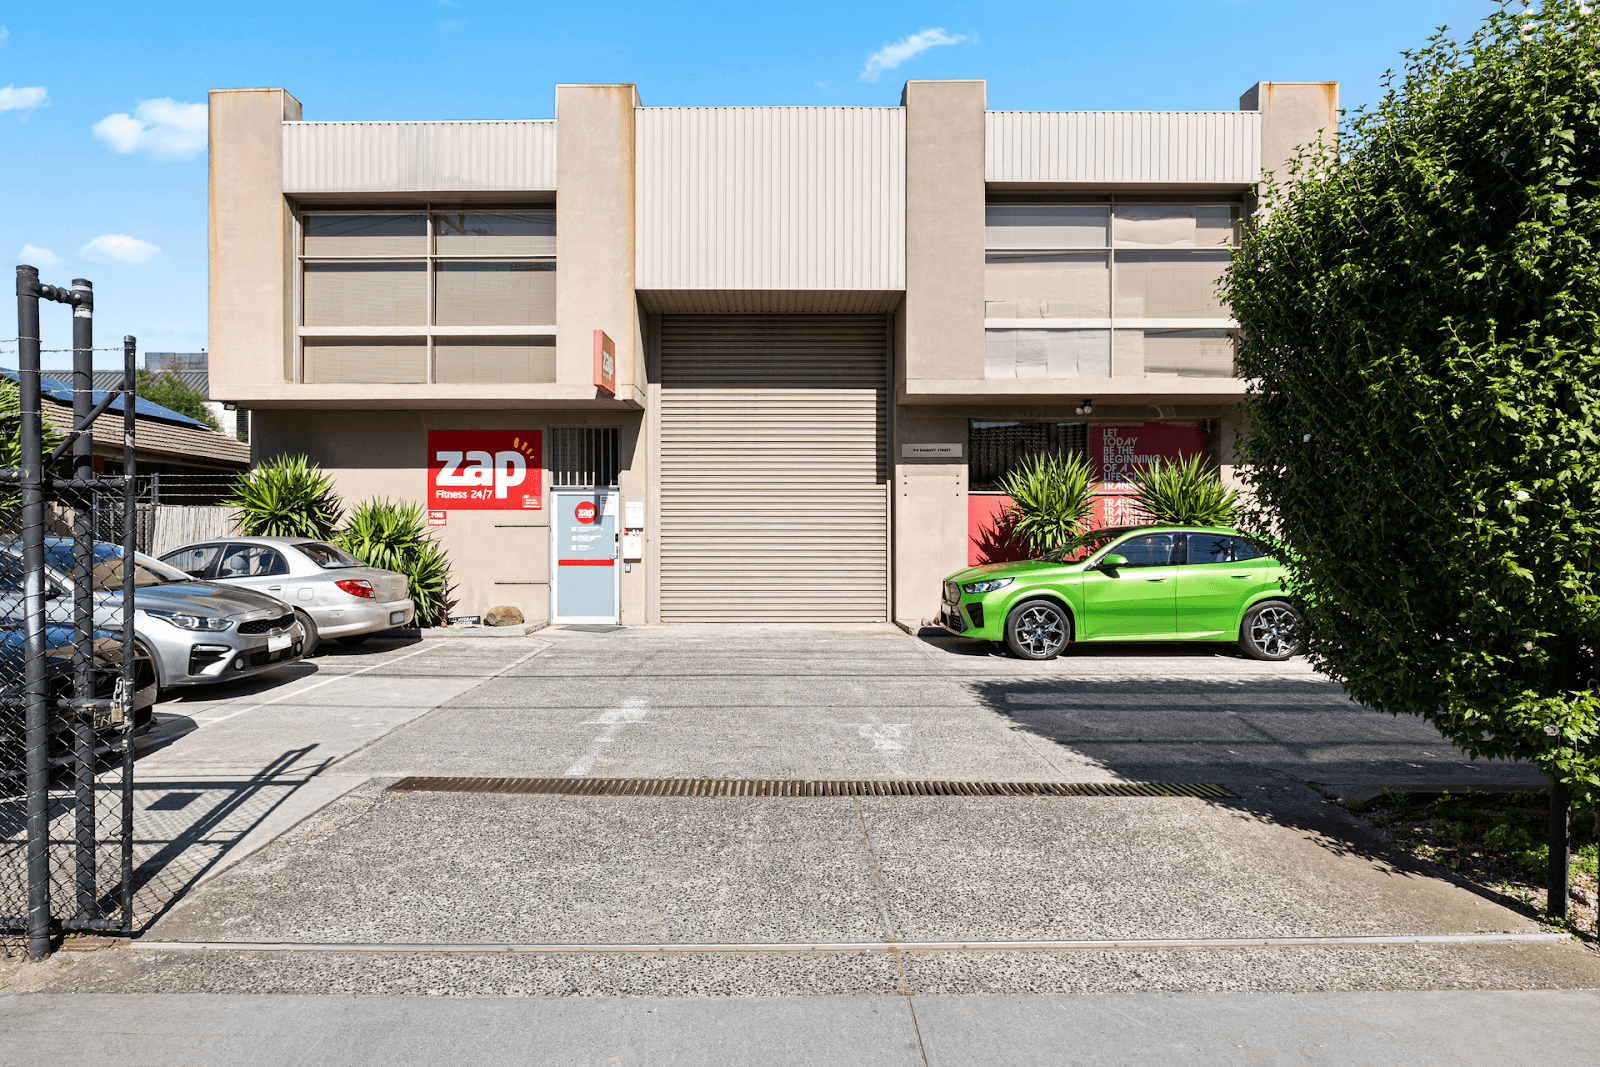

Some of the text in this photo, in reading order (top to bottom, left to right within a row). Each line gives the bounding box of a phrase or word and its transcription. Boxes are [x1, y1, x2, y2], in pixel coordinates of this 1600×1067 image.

[602, 350, 614, 381] zap
[1103, 428, 1118, 437] LET
[1103, 437, 1138, 446] TODAY
[1103, 446, 1135, 455] BE THE
[1103, 455, 1161, 464] BEGINNING
[1103, 463, 1128, 472] OF A
[436, 451, 526, 499] zap
[436, 488, 493, 500] Fitness 24/7
[578, 509, 595, 519] zap
